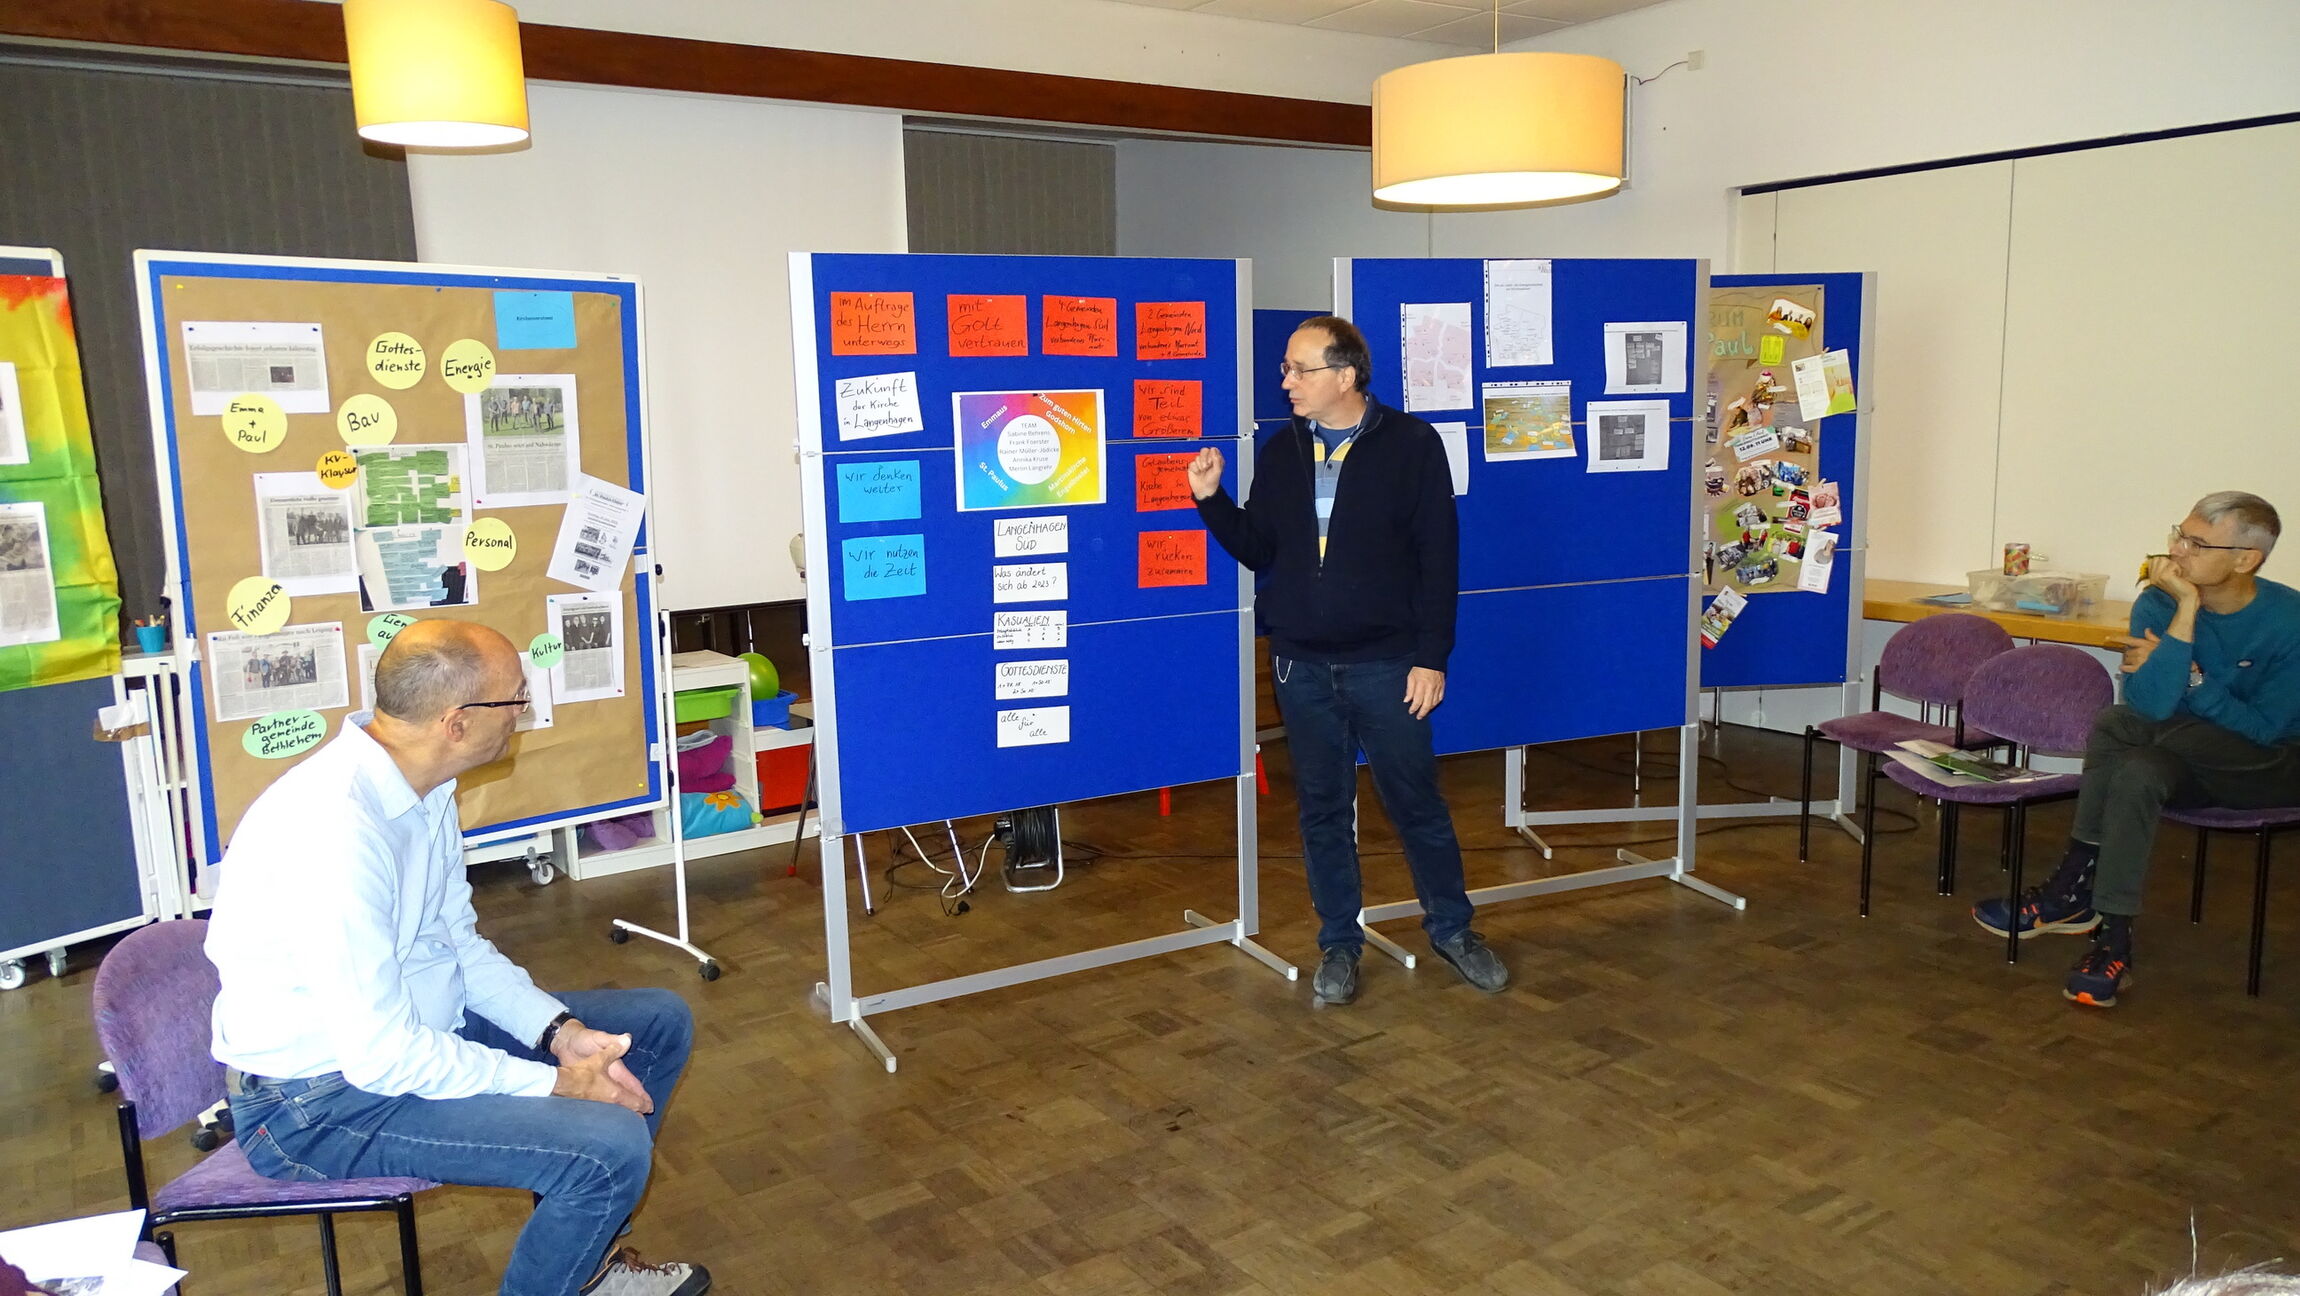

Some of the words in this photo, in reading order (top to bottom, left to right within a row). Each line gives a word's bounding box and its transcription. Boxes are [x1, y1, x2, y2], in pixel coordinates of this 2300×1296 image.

[959, 299, 983, 312] mit
[858, 314, 906, 334] Herrn
[951, 314, 1002, 335] Gott
[375, 340, 422, 354] Gottes-
[843, 336, 906, 349] unterwegs
[958, 335, 1026, 349] vertrauen
[375, 358, 422, 373] dienste
[444, 356, 492, 378] Energie
[840, 378, 908, 399] Zukunft
[870, 397, 900, 410] Kirche
[1038, 392, 1055, 407] Zum
[1052, 403, 1073, 420] guten
[1148, 396, 1184, 410] Teil
[854, 410, 914, 432] Langenhagen
[981, 404, 1008, 429] Emmaus
[1044, 409, 1077, 436] Godshorn
[237, 429, 267, 444] Paul
[873, 468, 913, 482] denken
[986, 469, 1009, 492] Paulus
[864, 483, 904, 495] weiter
[997, 521, 1067, 537] LANGENHAGEN
[465, 531, 513, 549] Personal
[886, 544, 919, 560] nutzen
[863, 564, 880, 579] die
[883, 562, 918, 578] Zeit
[994, 567, 1012, 578] Was
[997, 578, 1014, 592] sich
[1016, 580, 1028, 591] ab
[997, 613, 1050, 627] KASUALIEN
[531, 641, 562, 660] Kultur
[1000, 663, 1067, 678] GOTTESDIENSTE
[1000, 711, 1019, 723] alle
[1018, 717, 1034, 731] für
[261, 720, 316, 746] gemeinde
[1029, 728, 1048, 738] alle
[261, 732, 322, 755] Bethlehem
